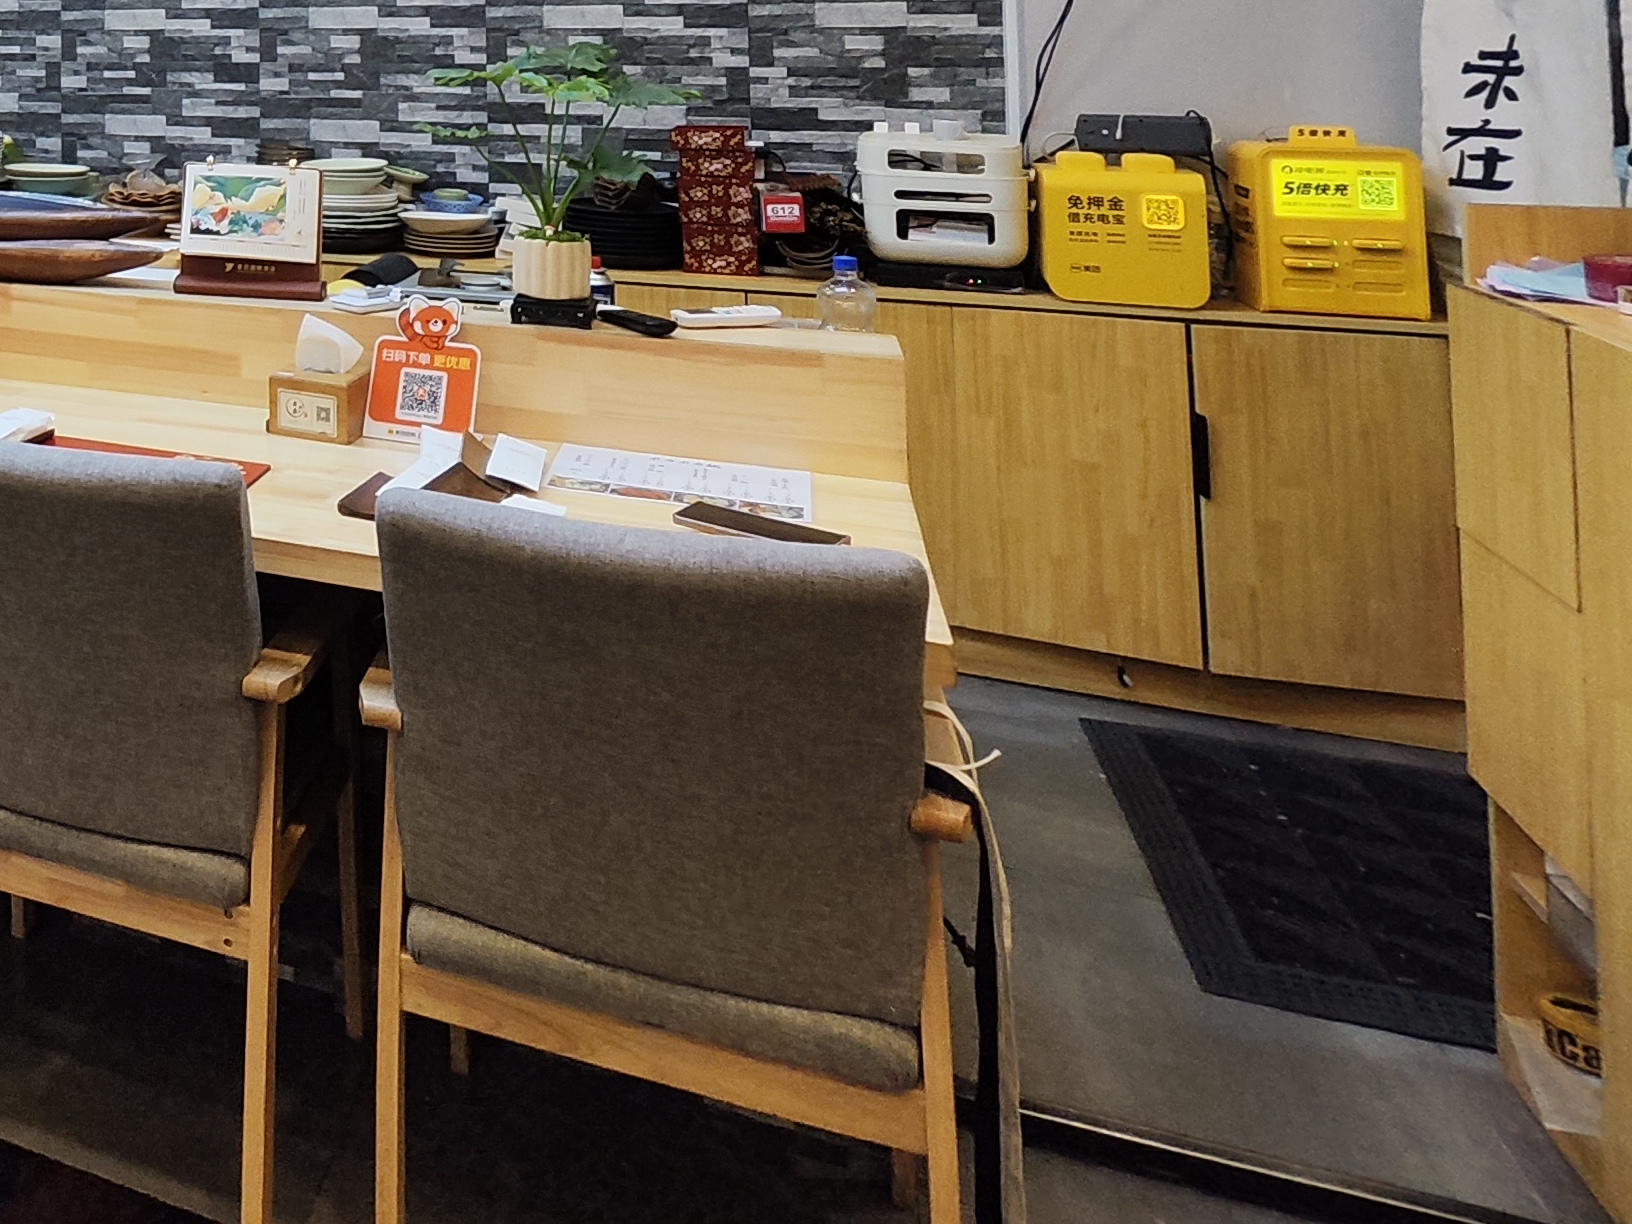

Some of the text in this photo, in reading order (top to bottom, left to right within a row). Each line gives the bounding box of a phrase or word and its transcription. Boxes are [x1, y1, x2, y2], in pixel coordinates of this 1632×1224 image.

[1297, 128, 1347, 137] 5倍快充
[1282, 181, 1350, 197] 5倍快充
[771, 206, 796, 215] 612
[1067, 195, 1125, 211] 免押金
[382, 347, 472, 371] 扫码下单 更优惠
